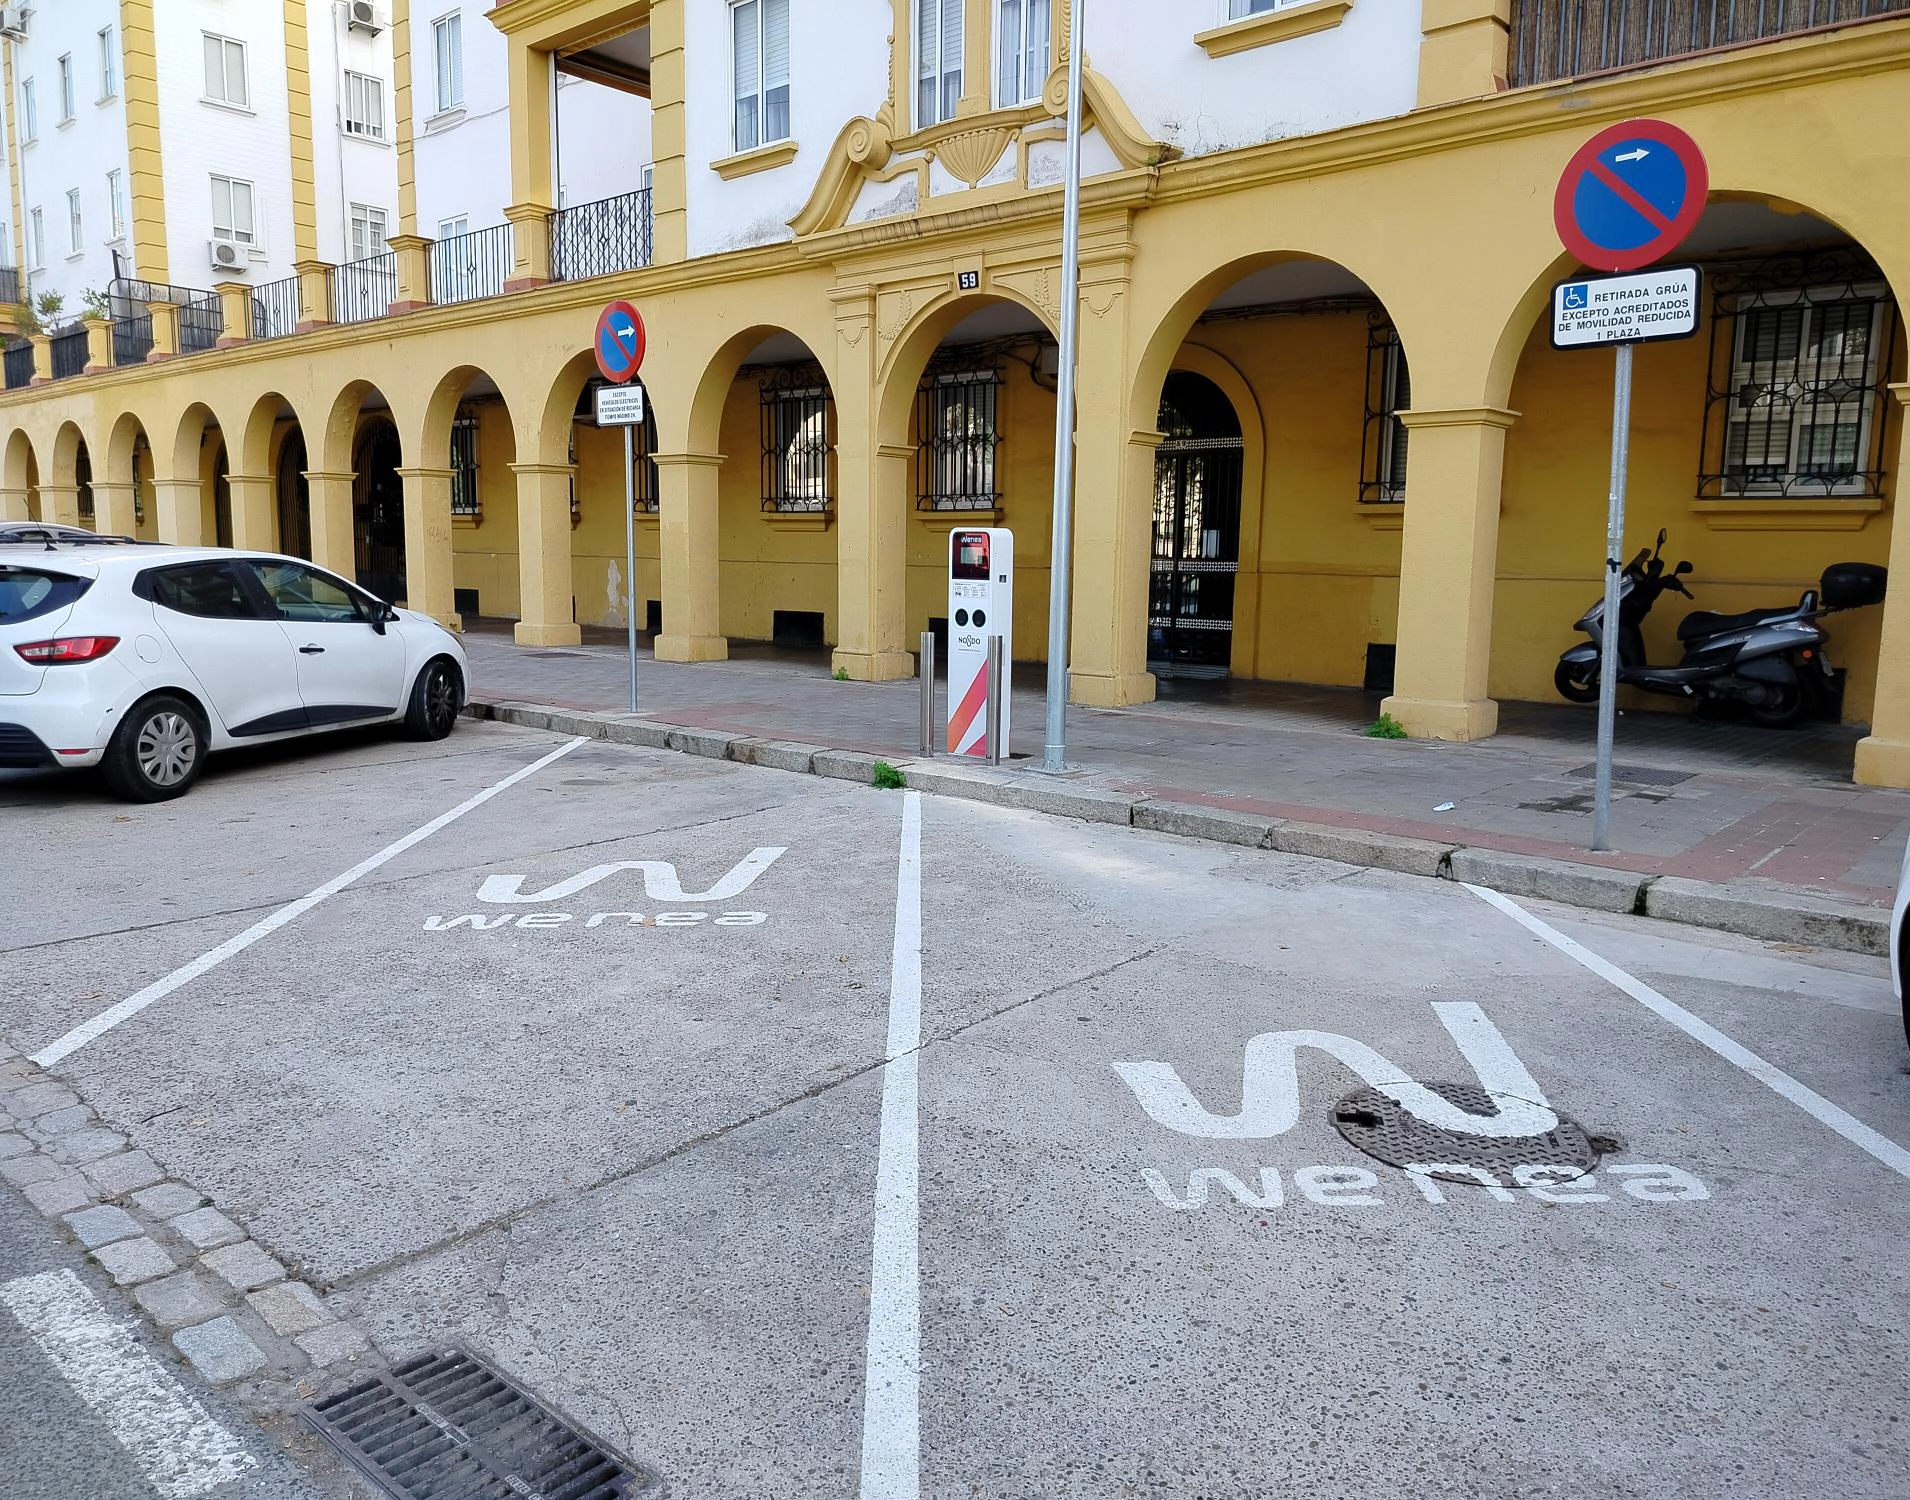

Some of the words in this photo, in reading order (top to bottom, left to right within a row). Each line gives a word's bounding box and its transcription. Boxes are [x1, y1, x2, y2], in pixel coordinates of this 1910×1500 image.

[961, 273, 976, 288] 59
[1594, 288, 1650, 303] RETIRADA
[1655, 282, 1688, 295] GRÚA
[1558, 322, 1571, 332] DE
[1576, 316, 1632, 330] MOVILIDAD
[1637, 309, 1691, 323] REDUCIDA
[1562, 307, 1609, 321] EXCEPTO
[1613, 299, 1689, 315] ACREDITADOS
[1596, 332, 1601, 340] 1
[1606, 327, 1641, 339] PLAZA
[423, 911, 768, 931] wenea
[1140, 1163, 1712, 1209] wenea
